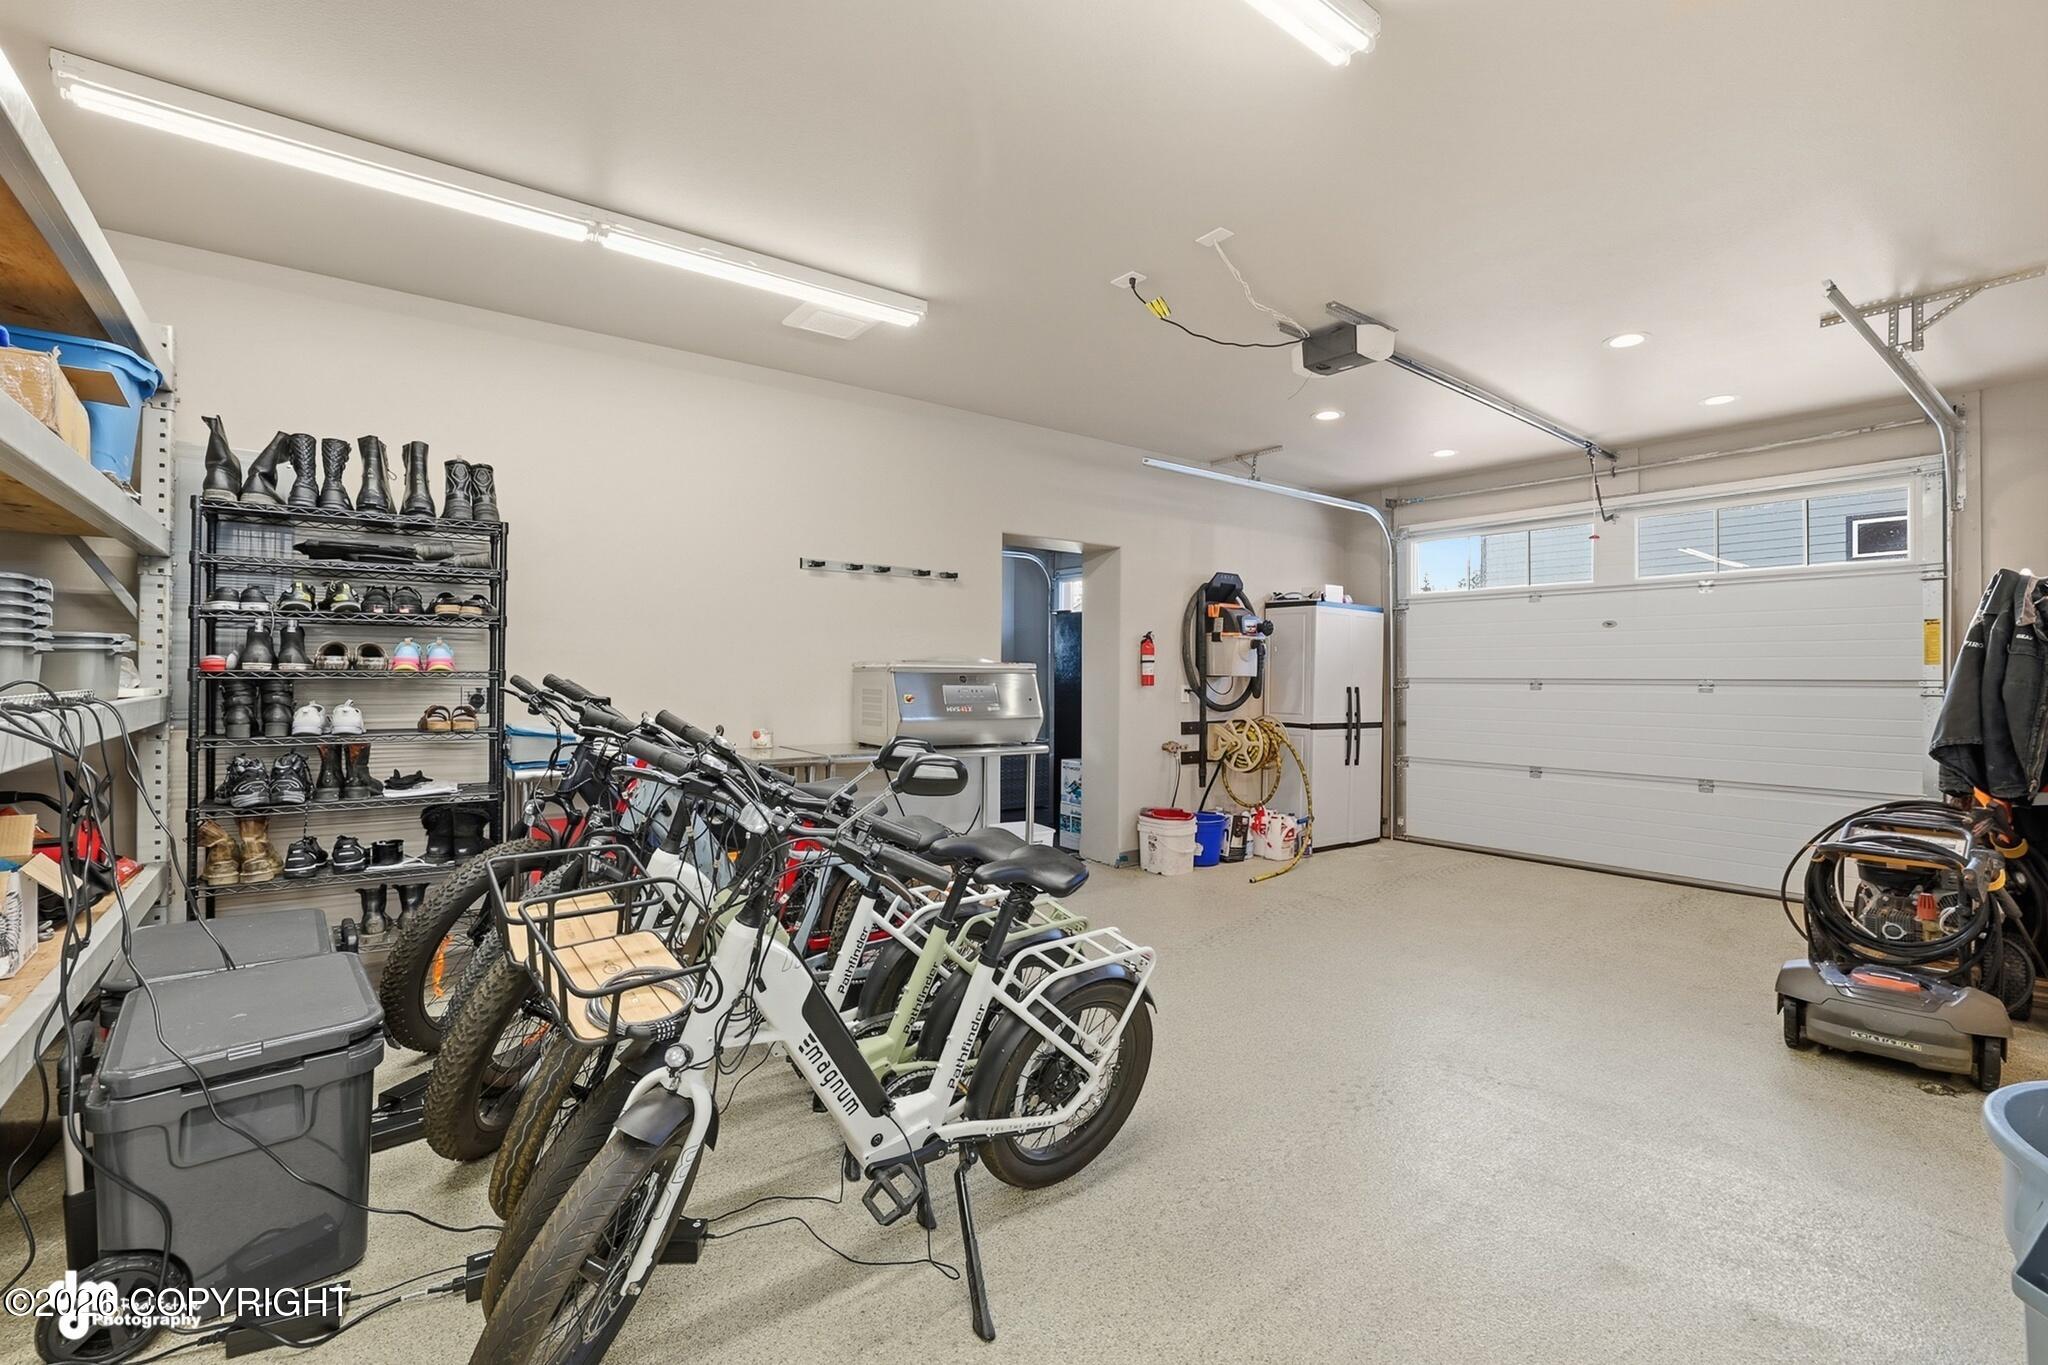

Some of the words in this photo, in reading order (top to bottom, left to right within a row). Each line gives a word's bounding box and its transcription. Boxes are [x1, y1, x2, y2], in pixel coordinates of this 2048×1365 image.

[837, 926, 869, 995] Pathfinder
[903, 961, 939, 1034] Pathfinder
[804, 1044, 860, 1116] magnum
[948, 1003, 986, 1090] Pathfinder
